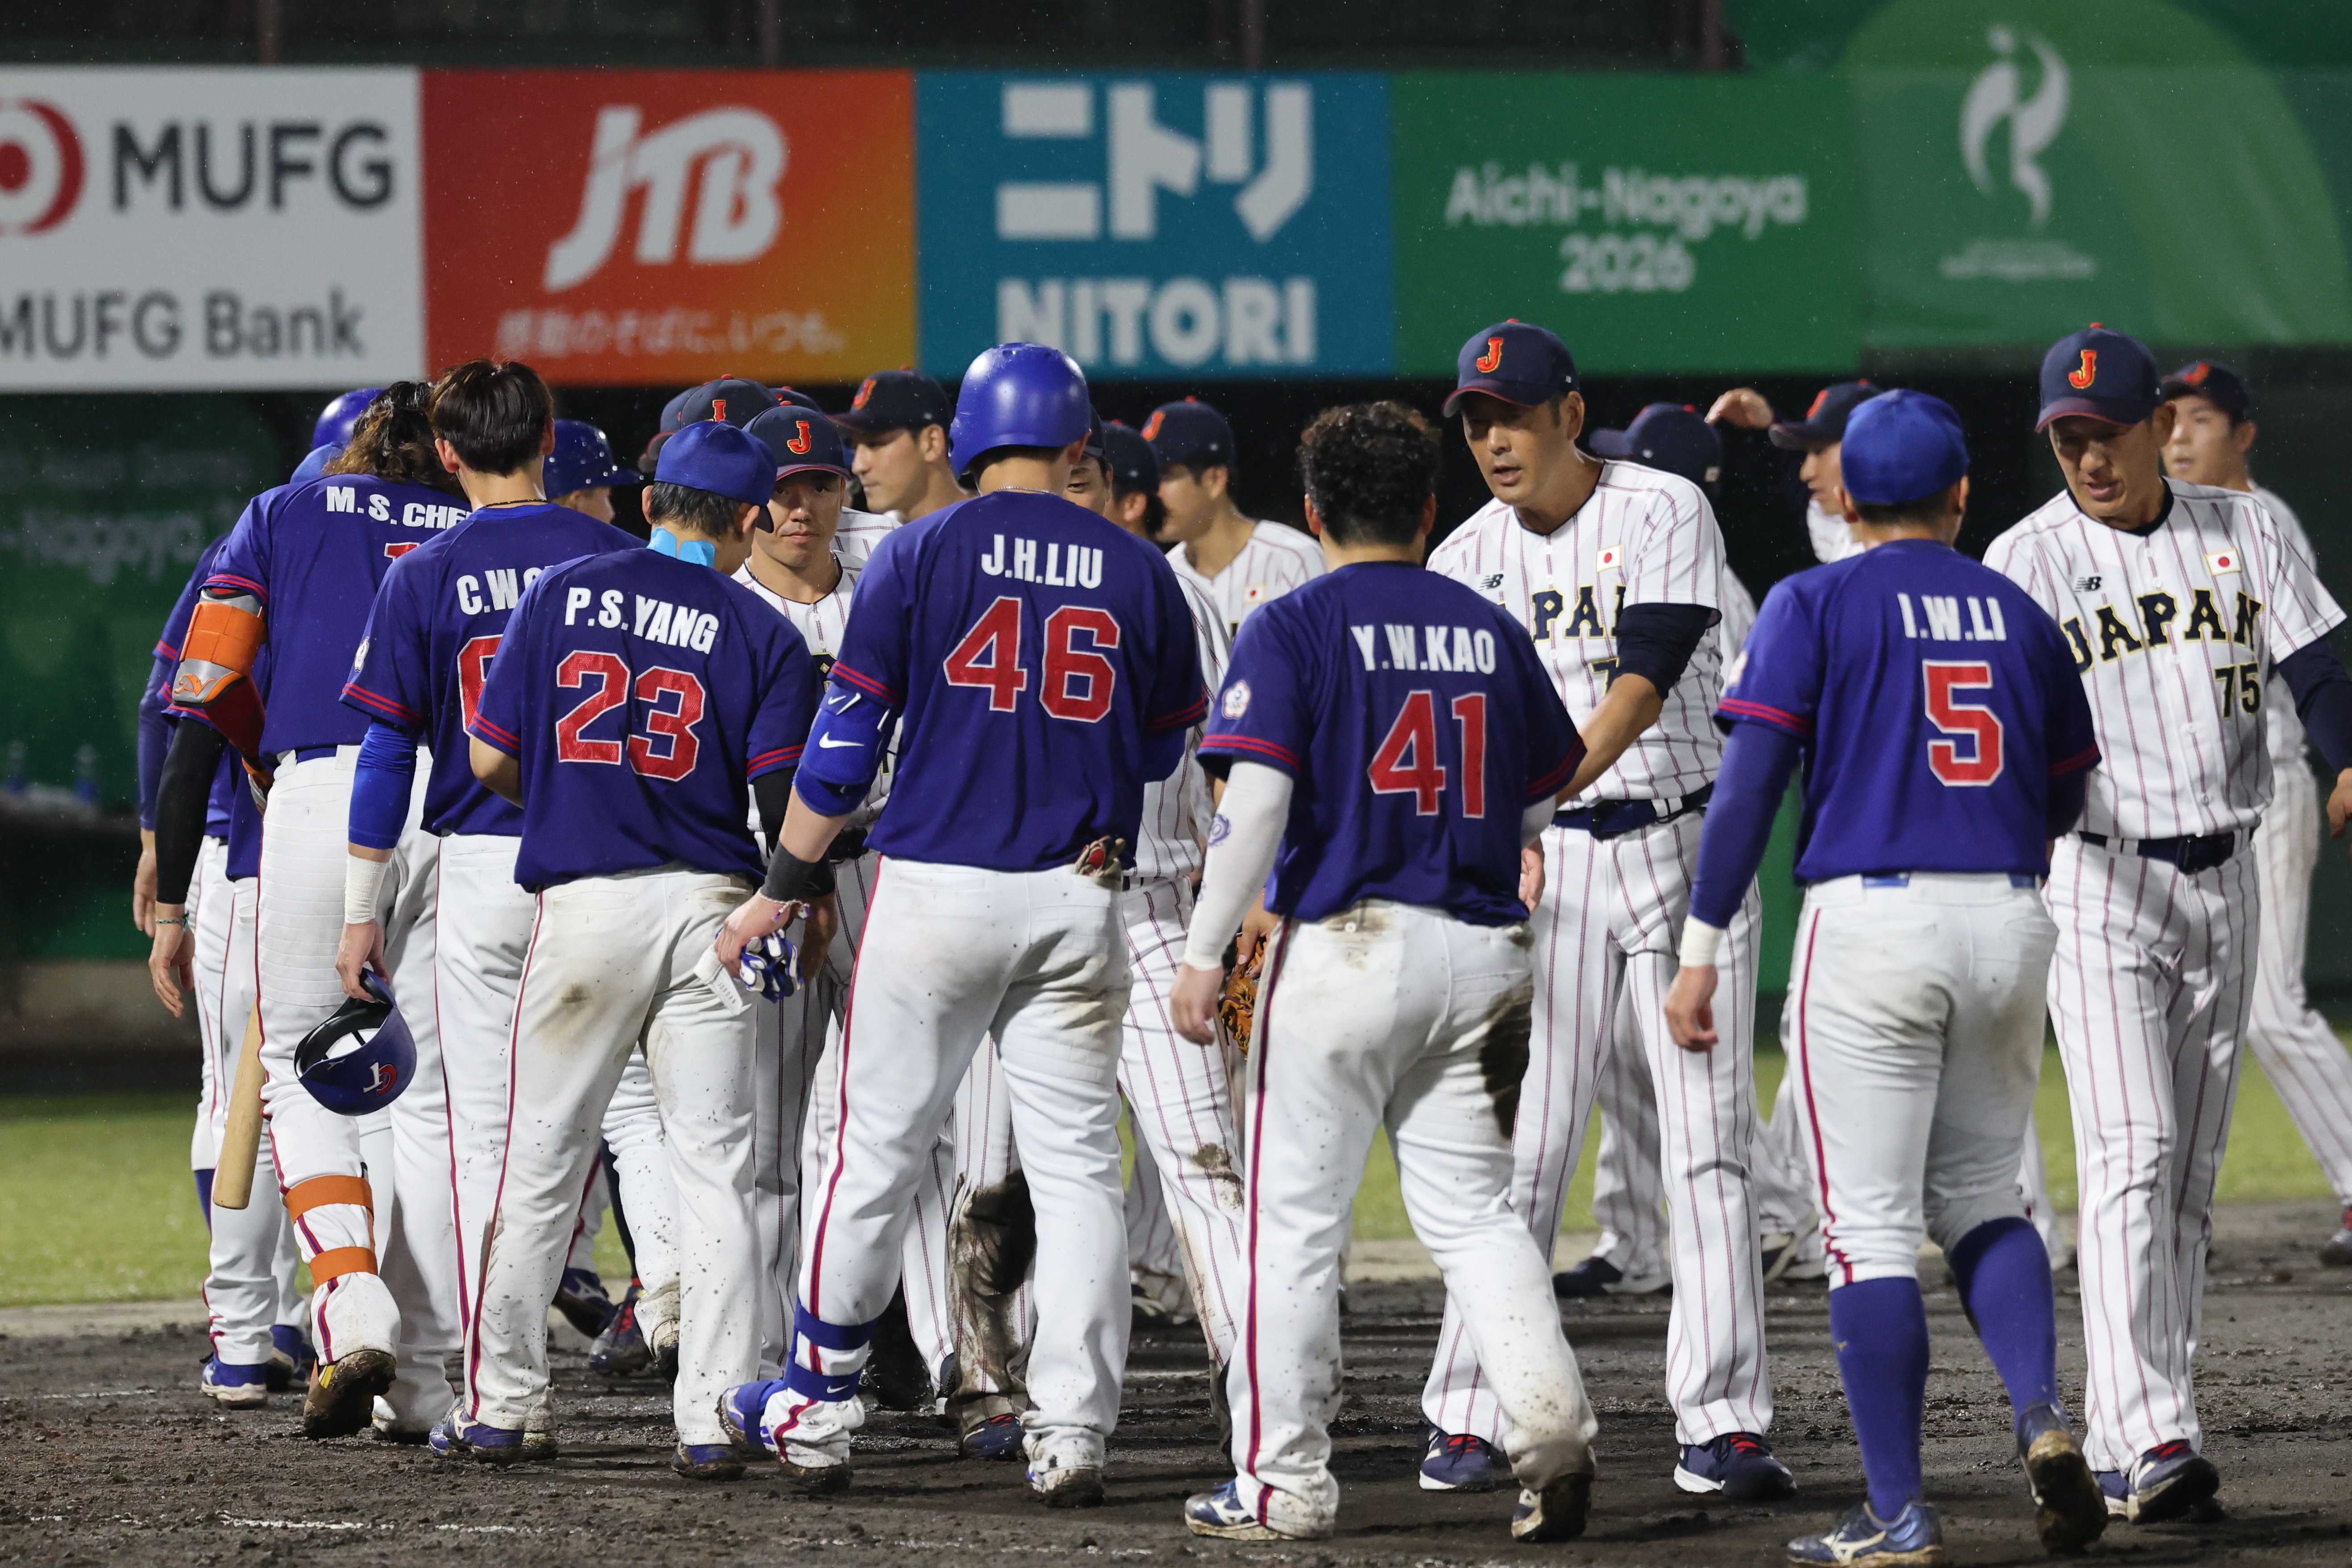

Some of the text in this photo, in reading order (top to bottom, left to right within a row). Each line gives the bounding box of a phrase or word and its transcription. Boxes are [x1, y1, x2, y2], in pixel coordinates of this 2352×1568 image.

[112, 119, 393, 214] MUFG
[544, 104, 789, 293] JTB
[995, 80, 1315, 243] ニトリ
[1445, 161, 1808, 241] Aichi-Nagoya
[1558, 232, 1696, 294] 2026
[203, 286, 364, 361] Bank
[995, 274, 1317, 366] NITORI
[1476, 337, 1503, 373] J
[2069, 349, 2097, 389] J
[787, 420, 812, 454] J
[326, 486, 473, 530] M.S.CHE
[981, 534, 1103, 589] J.H.LIU
[564, 587, 720, 654] P.S.YANG
[1350, 623, 1497, 676] Y.W.KAO
[2059, 588, 2265, 675] JAPAN
[943, 595, 1121, 724] 46
[2213, 661, 2261, 720] 75
[556, 649, 705, 782] 23
[1921, 659, 2004, 787] 5
[1367, 689, 1487, 819] 41
[717, 982, 737, 1005] JORDAN
